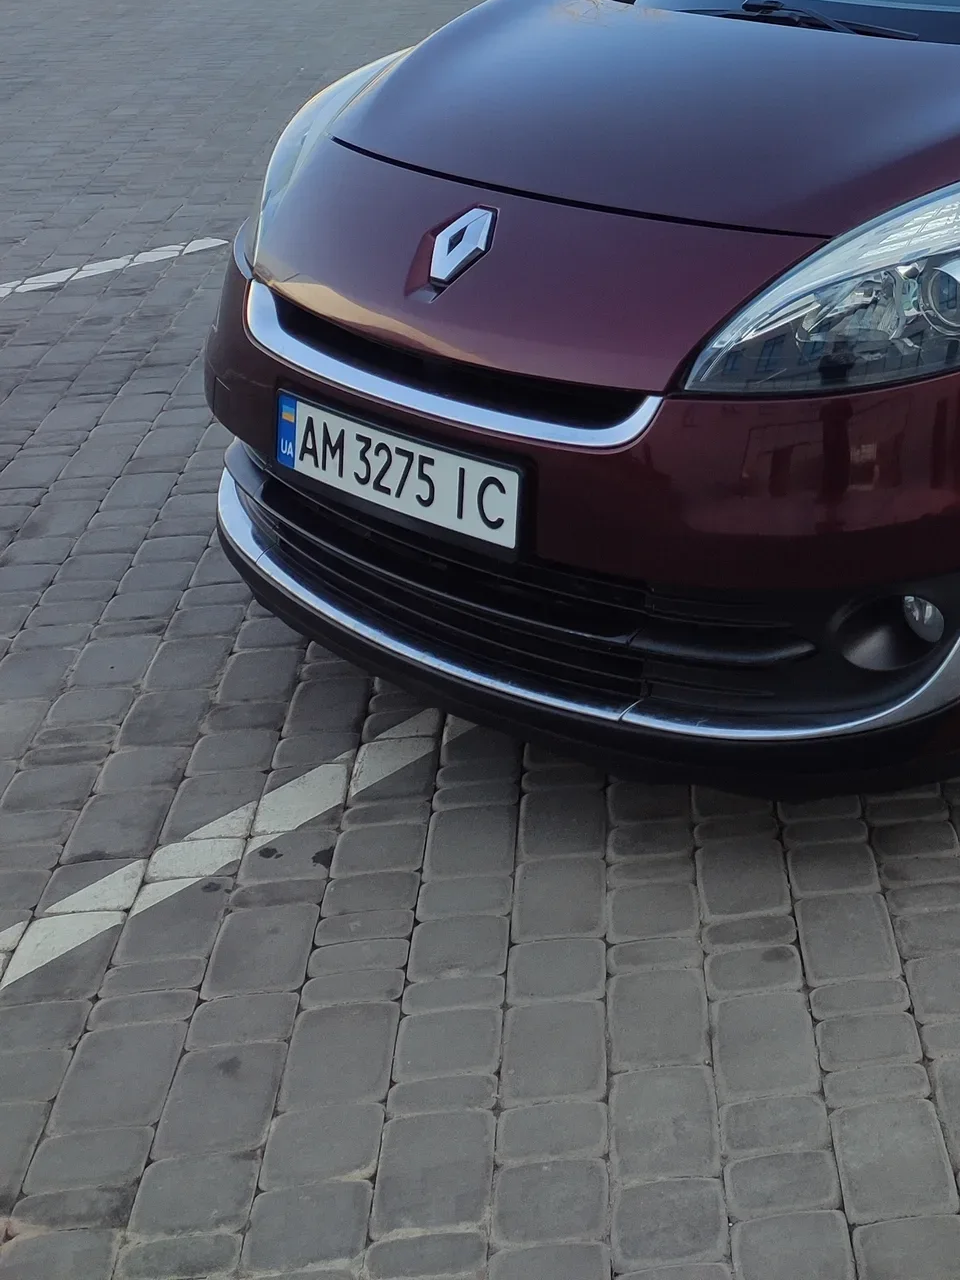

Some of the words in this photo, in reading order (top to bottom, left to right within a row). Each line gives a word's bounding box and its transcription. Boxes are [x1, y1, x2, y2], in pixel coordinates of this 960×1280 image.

[280, 437, 294, 458] UA
[299, 416, 345, 478] AM
[353, 432, 436, 508] 3275
[456, 467, 507, 530] IC
